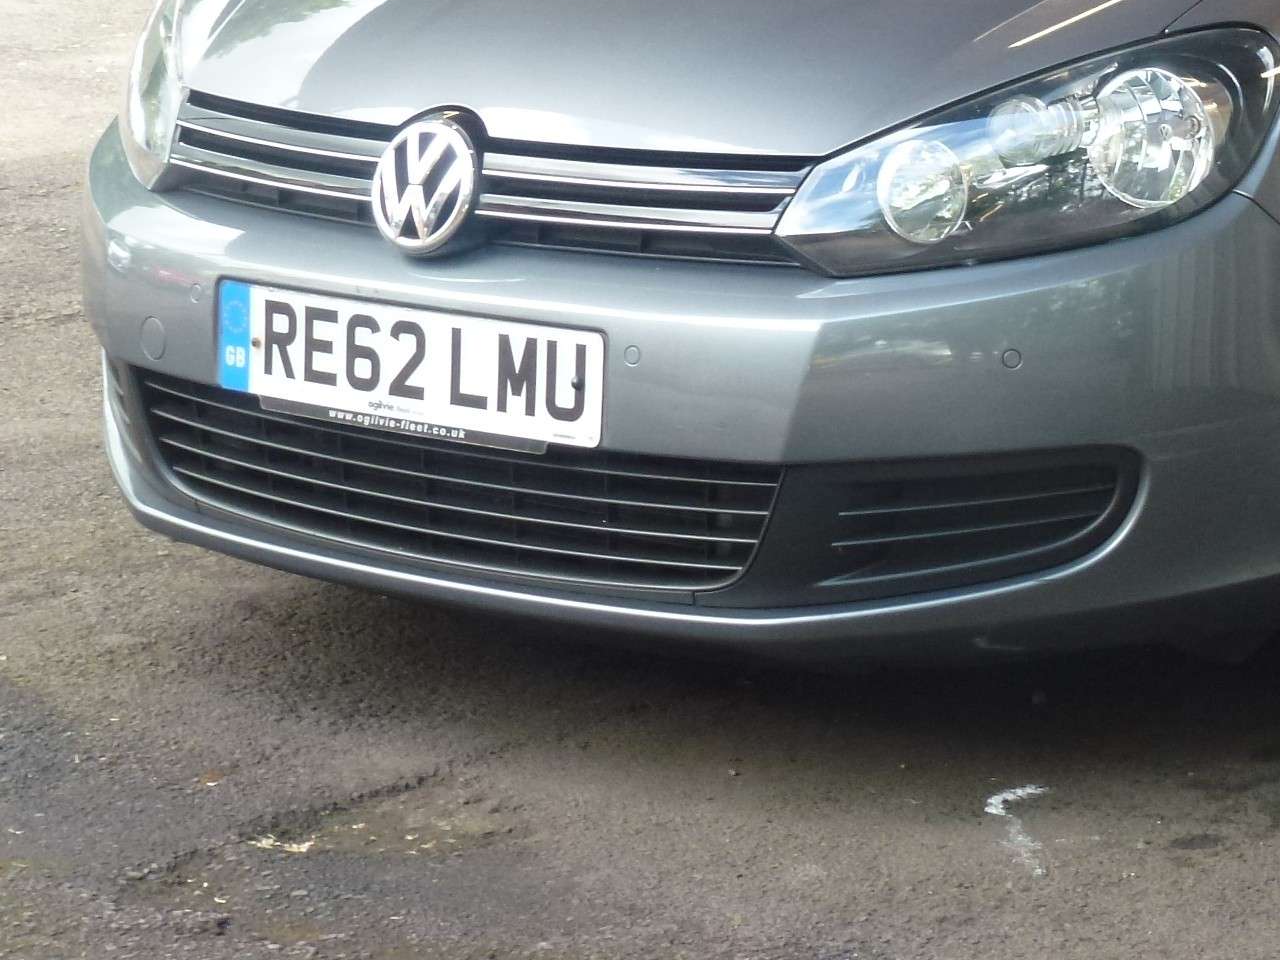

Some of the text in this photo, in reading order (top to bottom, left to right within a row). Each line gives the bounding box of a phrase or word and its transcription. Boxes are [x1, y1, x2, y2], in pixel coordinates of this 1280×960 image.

[225, 344, 246, 368] GB
[263, 299, 587, 422] RE62 LMU
[328, 408, 466, 439] www.ogilvie-fleet.co.uk
